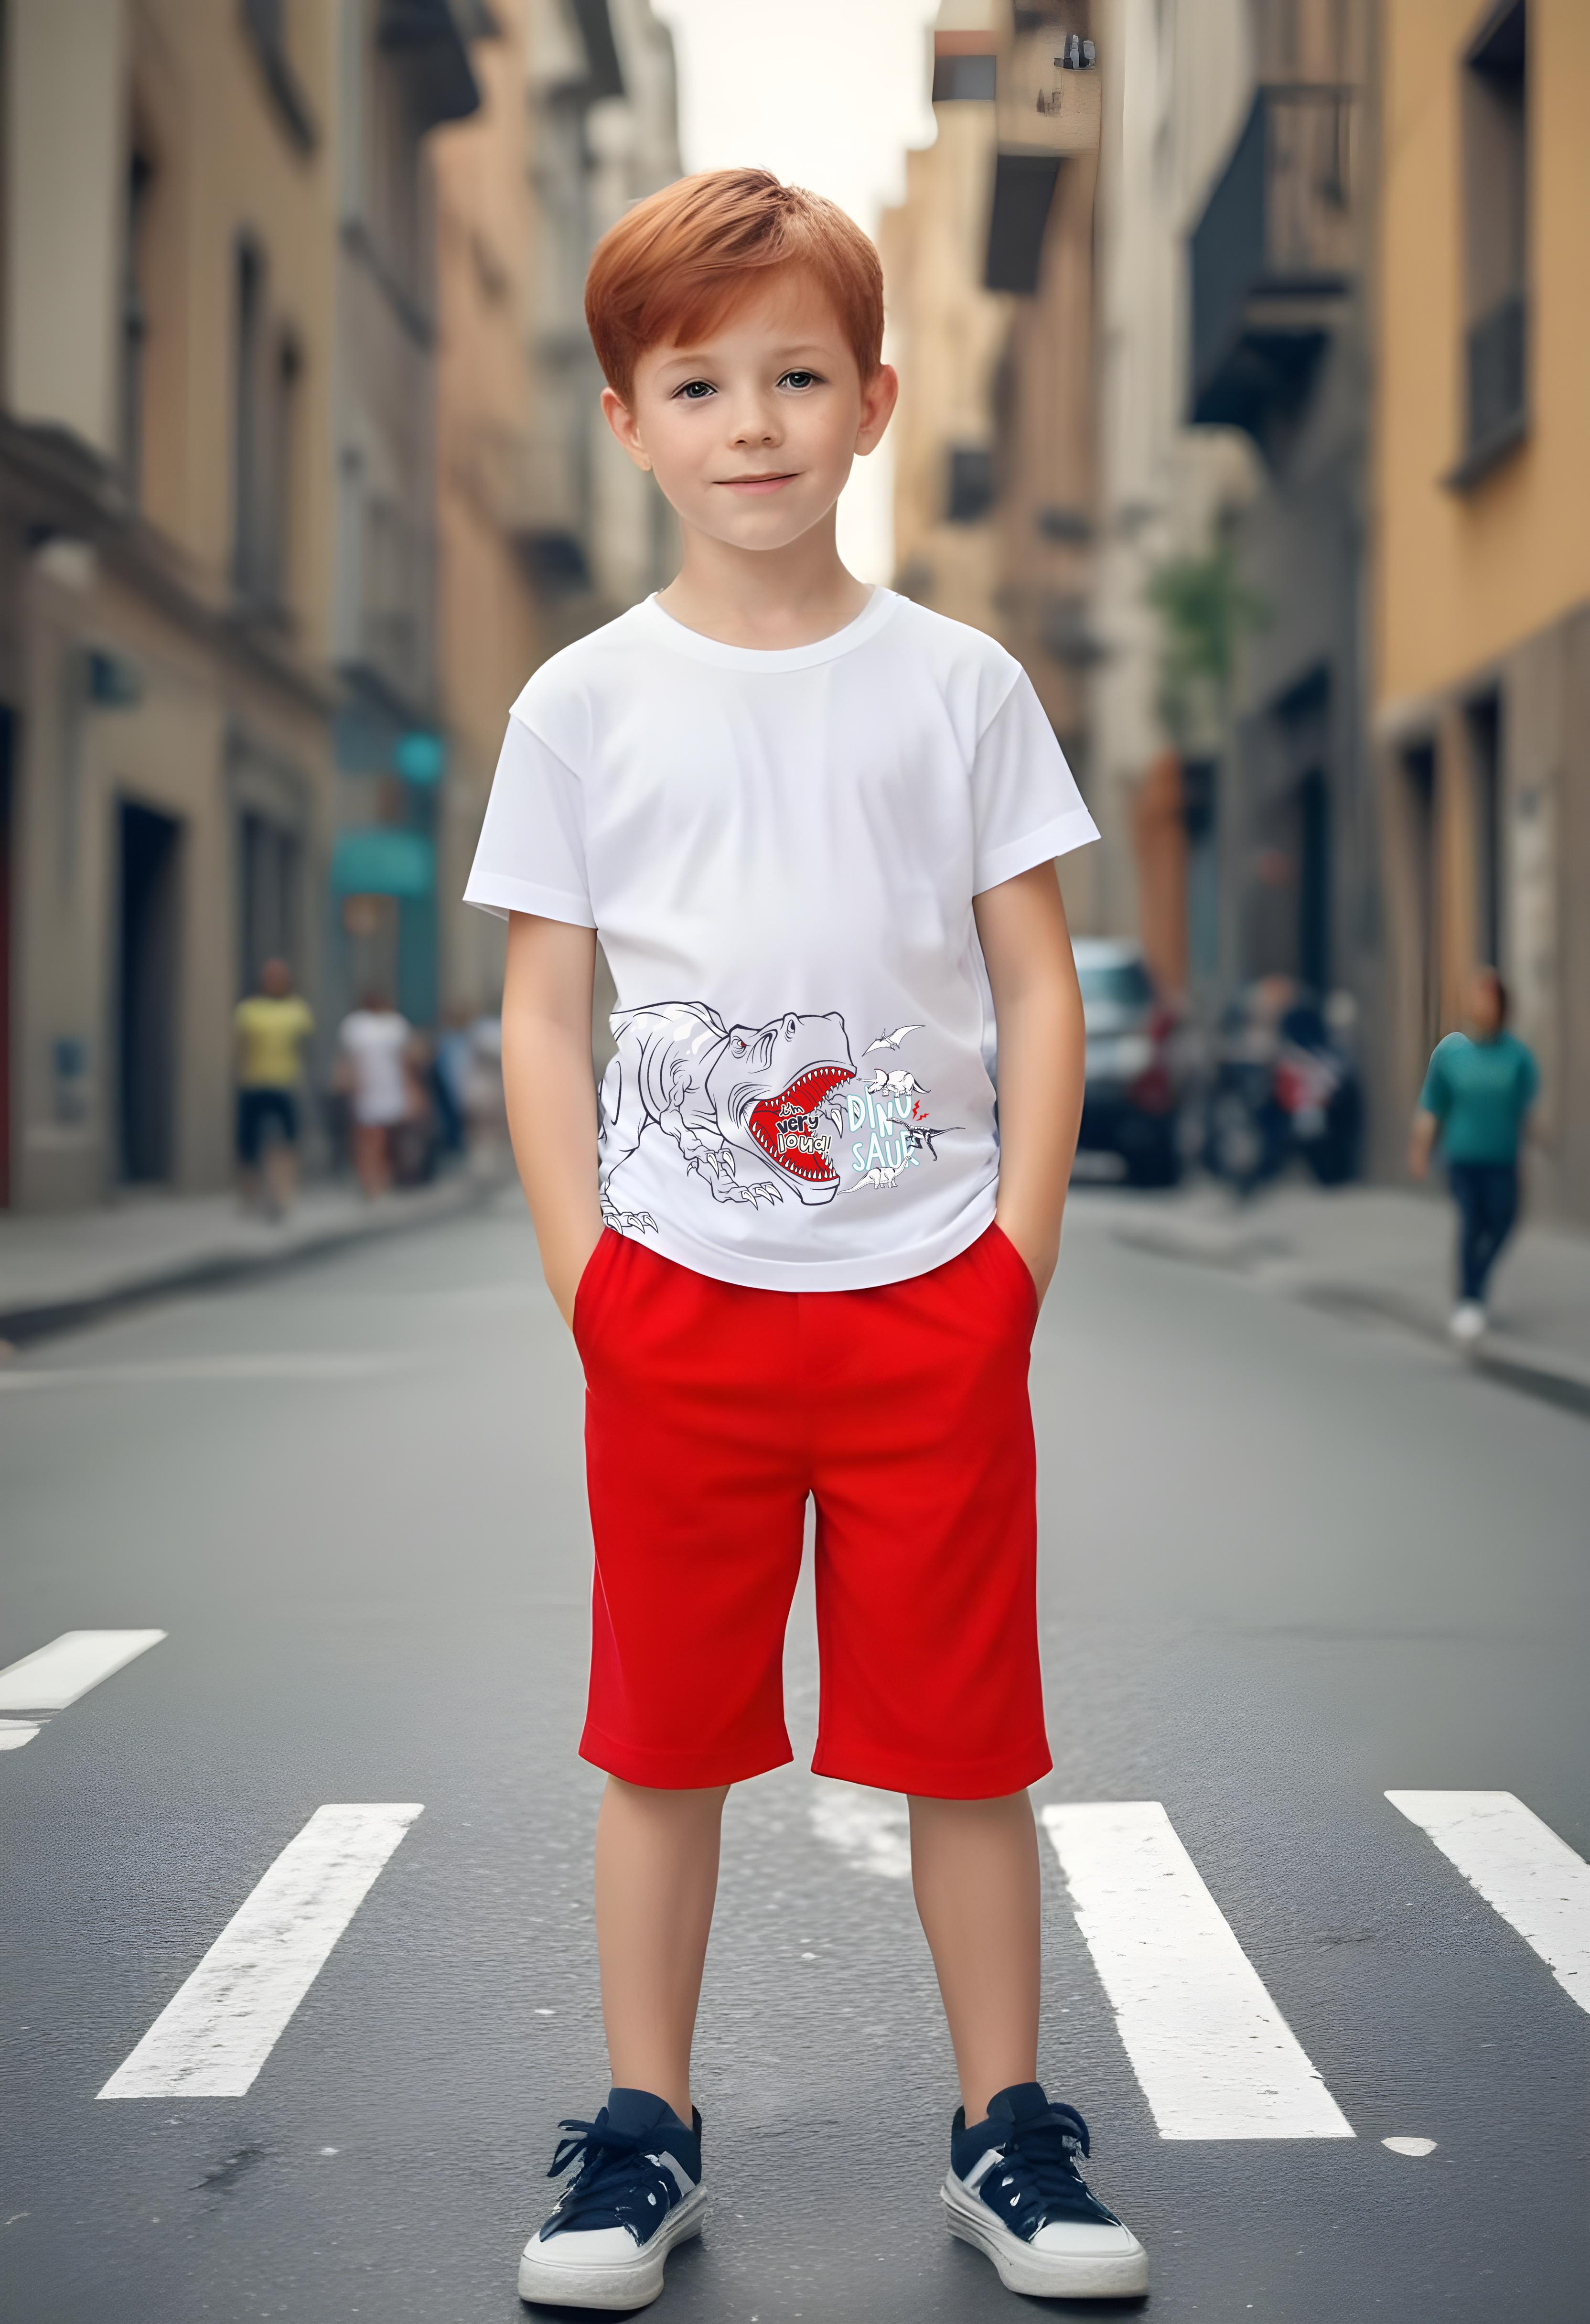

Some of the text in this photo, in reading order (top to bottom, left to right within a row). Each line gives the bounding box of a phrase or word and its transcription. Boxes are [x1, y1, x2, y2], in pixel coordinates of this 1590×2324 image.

[780, 1103, 804, 1116] i'm
[776, 1115, 819, 1134] very
[777, 1133, 832, 1154] loud!
